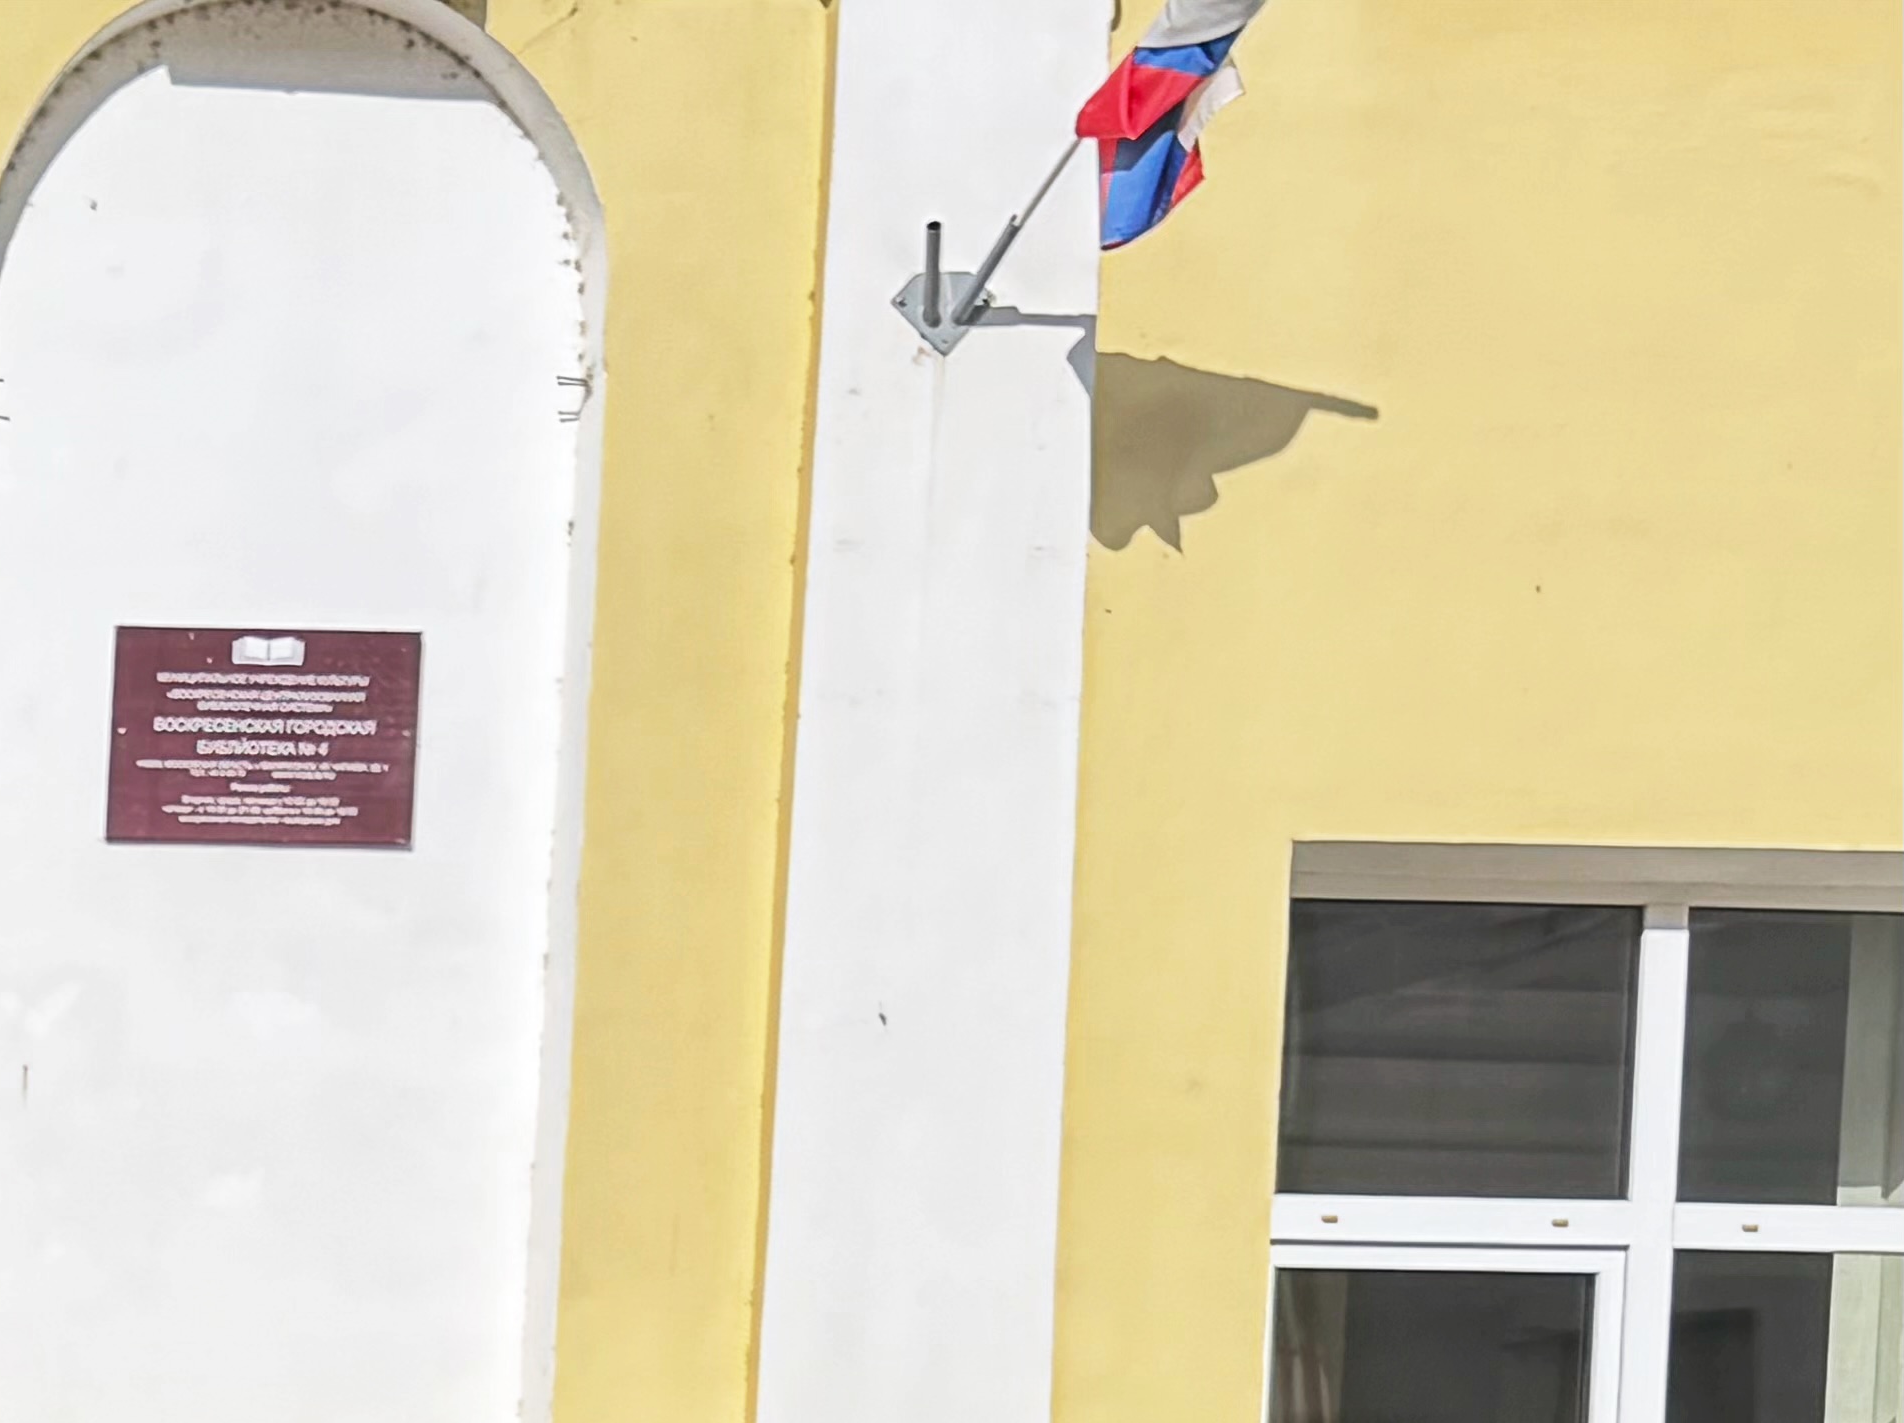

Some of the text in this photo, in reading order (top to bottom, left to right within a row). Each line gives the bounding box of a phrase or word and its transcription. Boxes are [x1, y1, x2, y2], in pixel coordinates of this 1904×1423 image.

[153, 716, 378, 737] ВОСКРЕСЕНСКАЯ ГОРОДСКАЯ
[196, 739, 297, 756] БИБЛИОТЕКА
